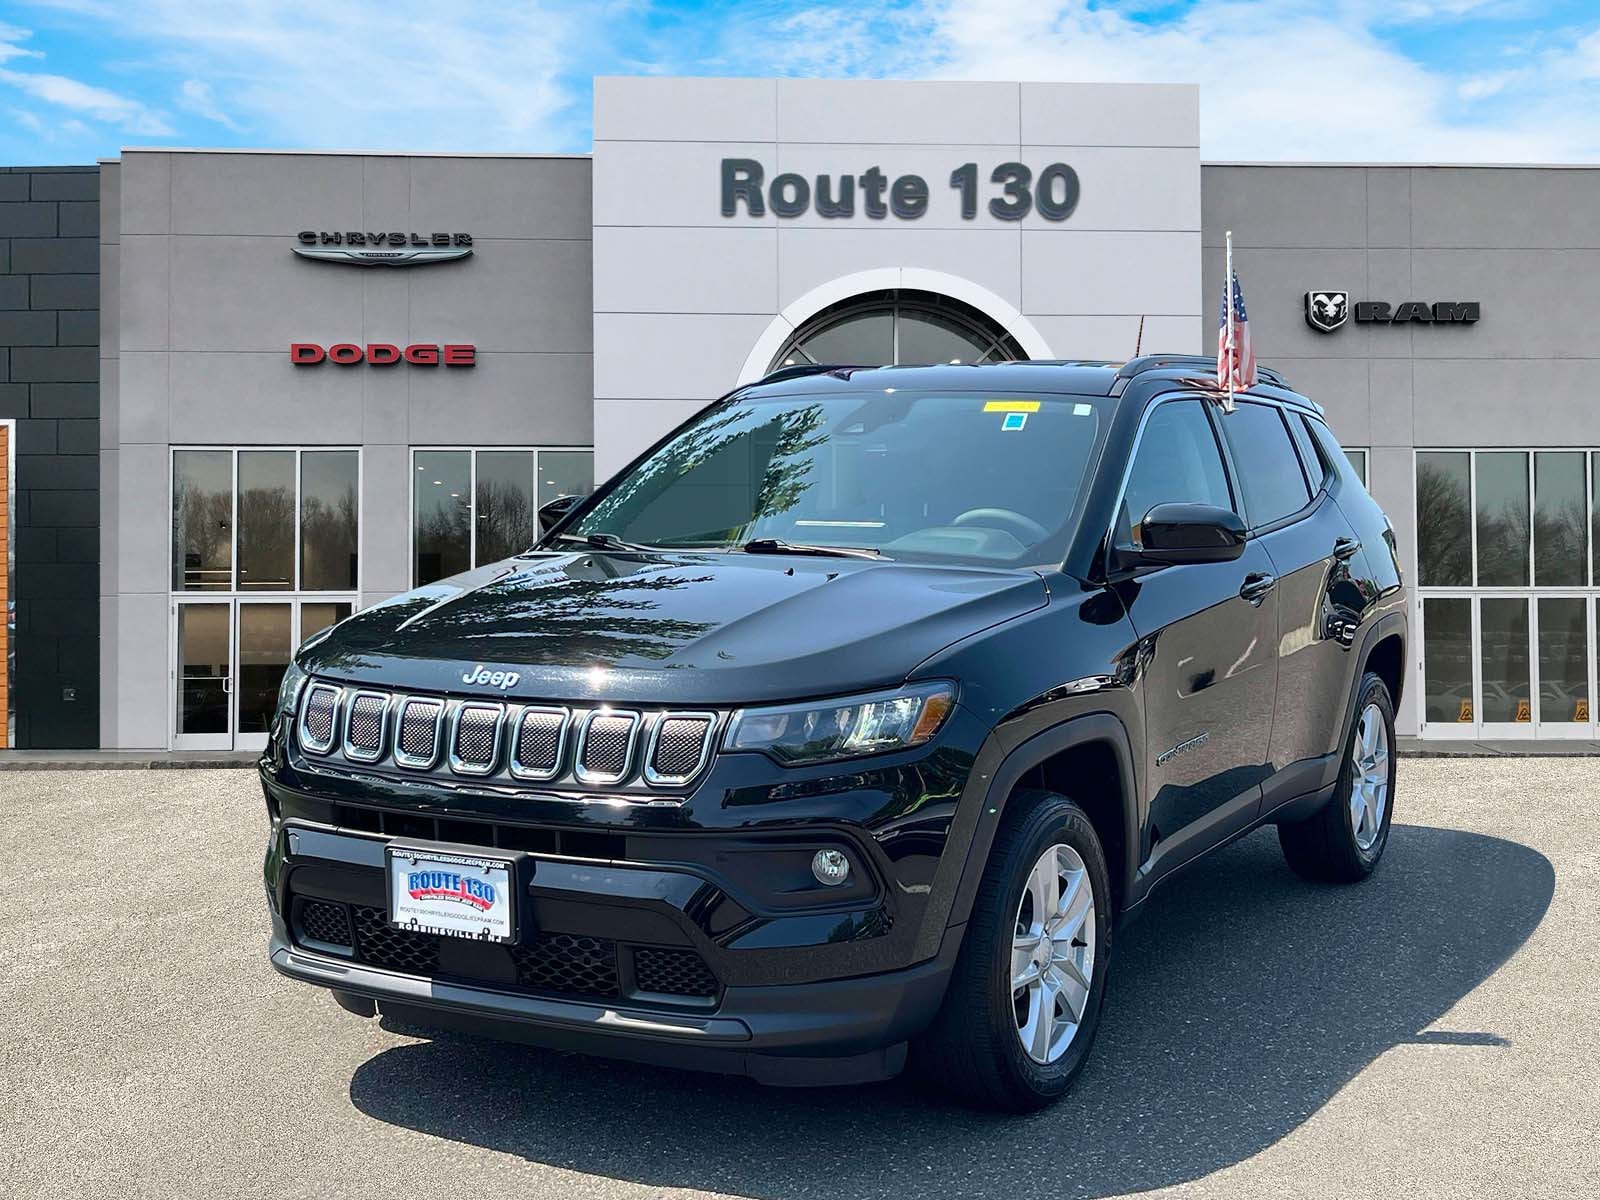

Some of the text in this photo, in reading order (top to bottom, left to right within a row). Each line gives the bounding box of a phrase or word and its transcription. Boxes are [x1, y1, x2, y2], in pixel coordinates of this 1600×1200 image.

[721, 158, 1080, 222] Route 130
[298, 231, 473, 246] CHRYSLER
[1355, 302, 1480, 323] RAM
[291, 343, 476, 366] DODGE
[463, 664, 520, 689] Jeep
[408, 870, 460, 892] ROUTE
[462, 876, 495, 904] 130
[487, 934, 502, 943] NJ
